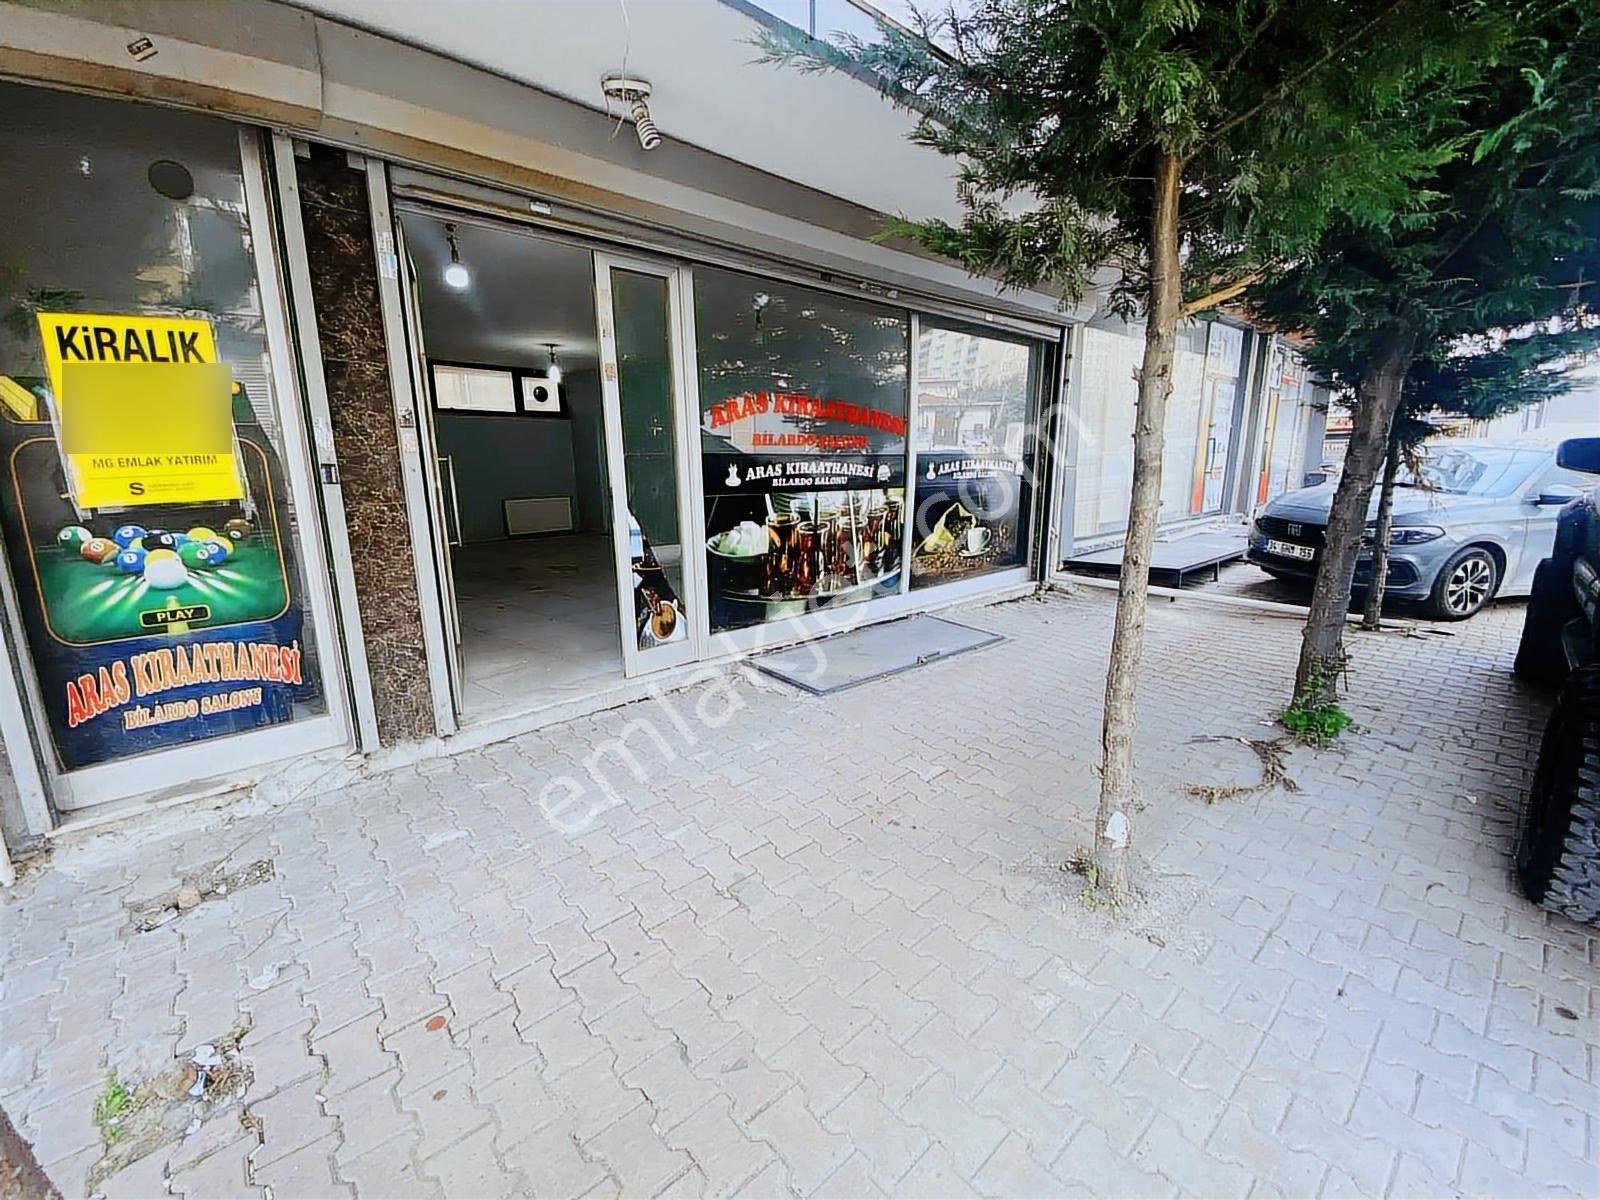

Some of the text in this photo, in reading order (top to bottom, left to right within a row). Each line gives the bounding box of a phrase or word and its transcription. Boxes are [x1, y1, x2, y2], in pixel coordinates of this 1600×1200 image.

[711, 391, 771, 429] ARAS
[92, 454, 218, 469] MG EMLAK YATIRIM
[744, 464, 782, 481] ARAS
[156, 608, 195, 623] PLAY
[65, 640, 303, 728] ARAS KIRAATHANESİ
[123, 687, 263, 730] BİLARDO SALONU
